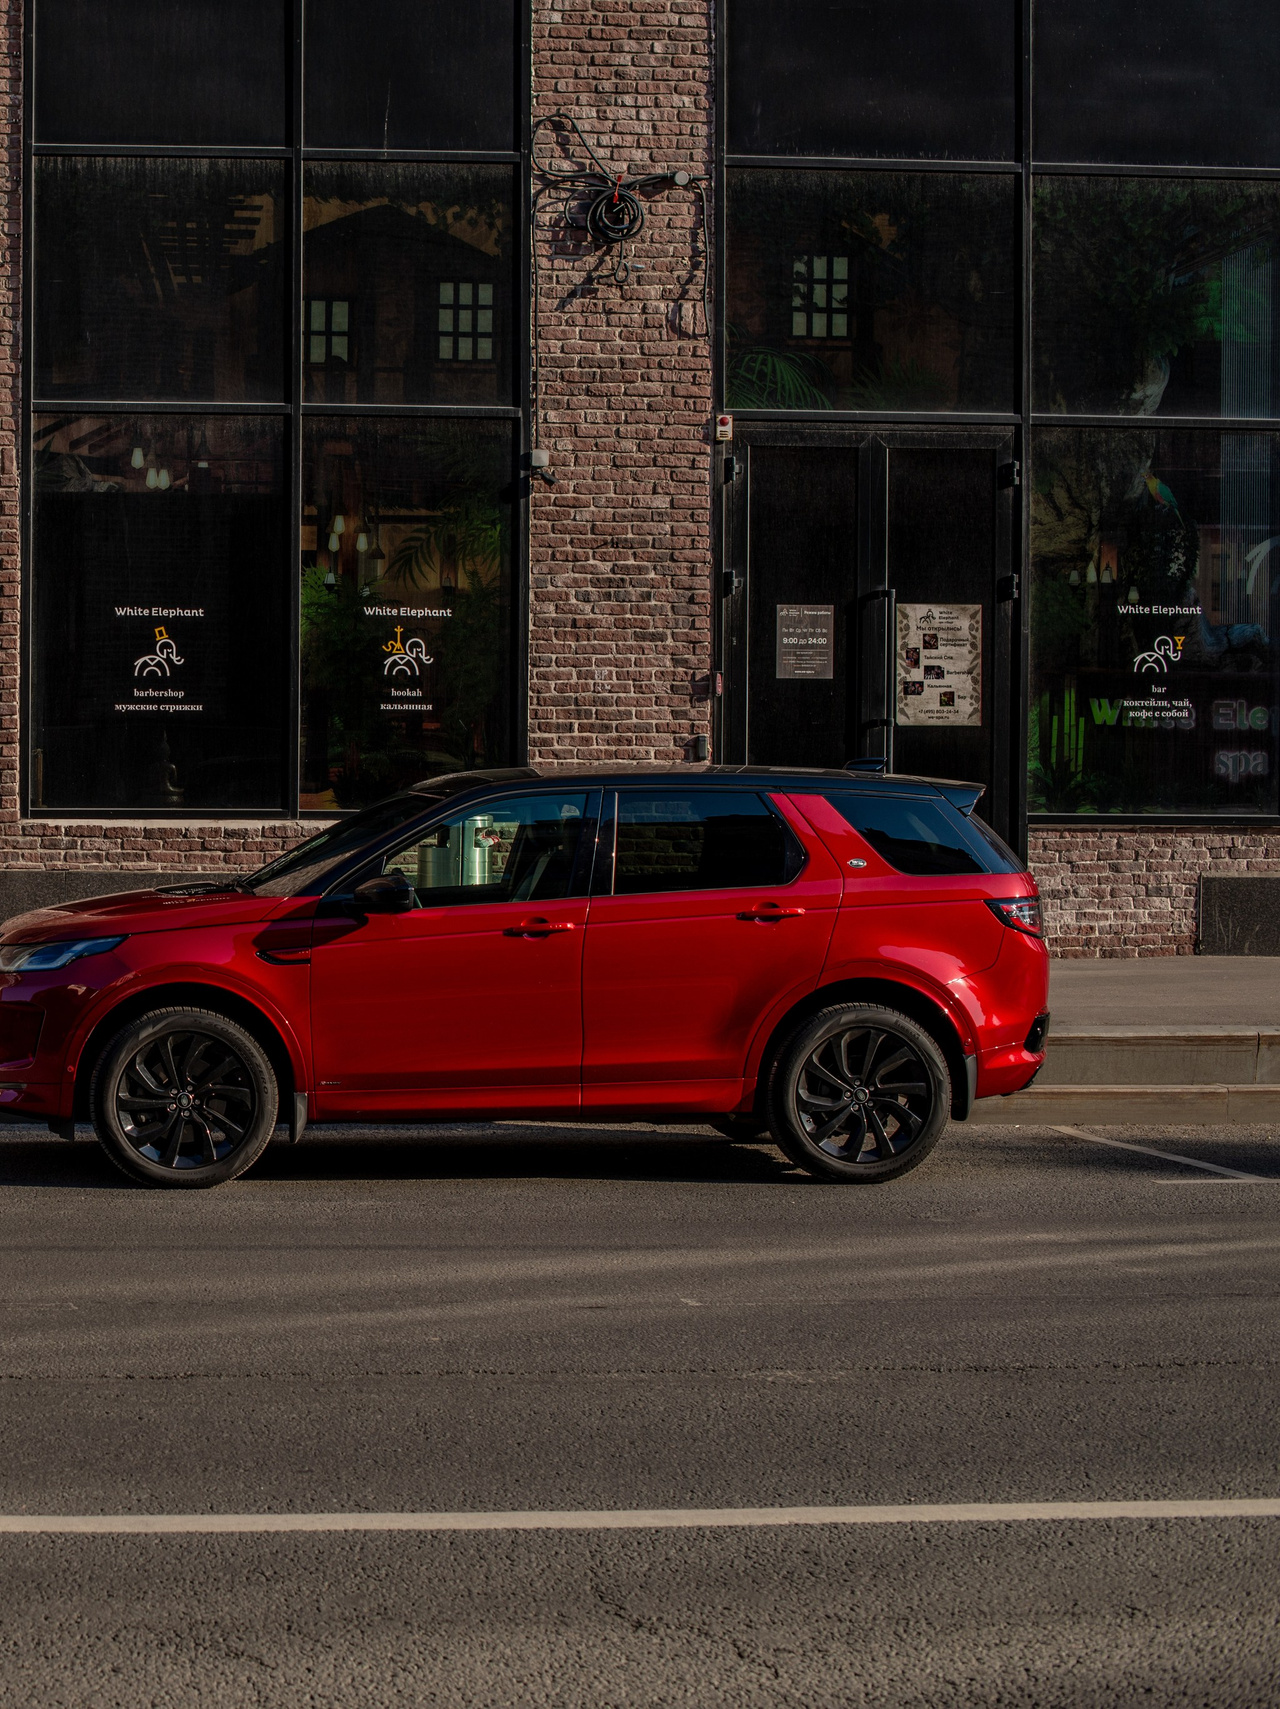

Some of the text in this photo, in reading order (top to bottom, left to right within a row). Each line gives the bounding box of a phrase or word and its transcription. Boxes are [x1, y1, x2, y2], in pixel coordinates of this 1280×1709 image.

[115, 606, 205, 618] White Elephant
[364, 606, 452, 618] White Elephant
[1118, 604, 1202, 616] White Elephant
[927, 625, 962, 633] открылись!
[134, 688, 185, 699] barbershop
[391, 688, 422, 697] hookah
[1151, 684, 1167, 693] bar
[380, 703, 433, 711] кальянная
[1123, 698, 1193, 708] коктейли, чай,
[114, 704, 204, 713] мужские стрижки
[1129, 709, 1153, 719] кофе
[1161, 709, 1189, 717] собой
[1215, 752, 1269, 782] spa
